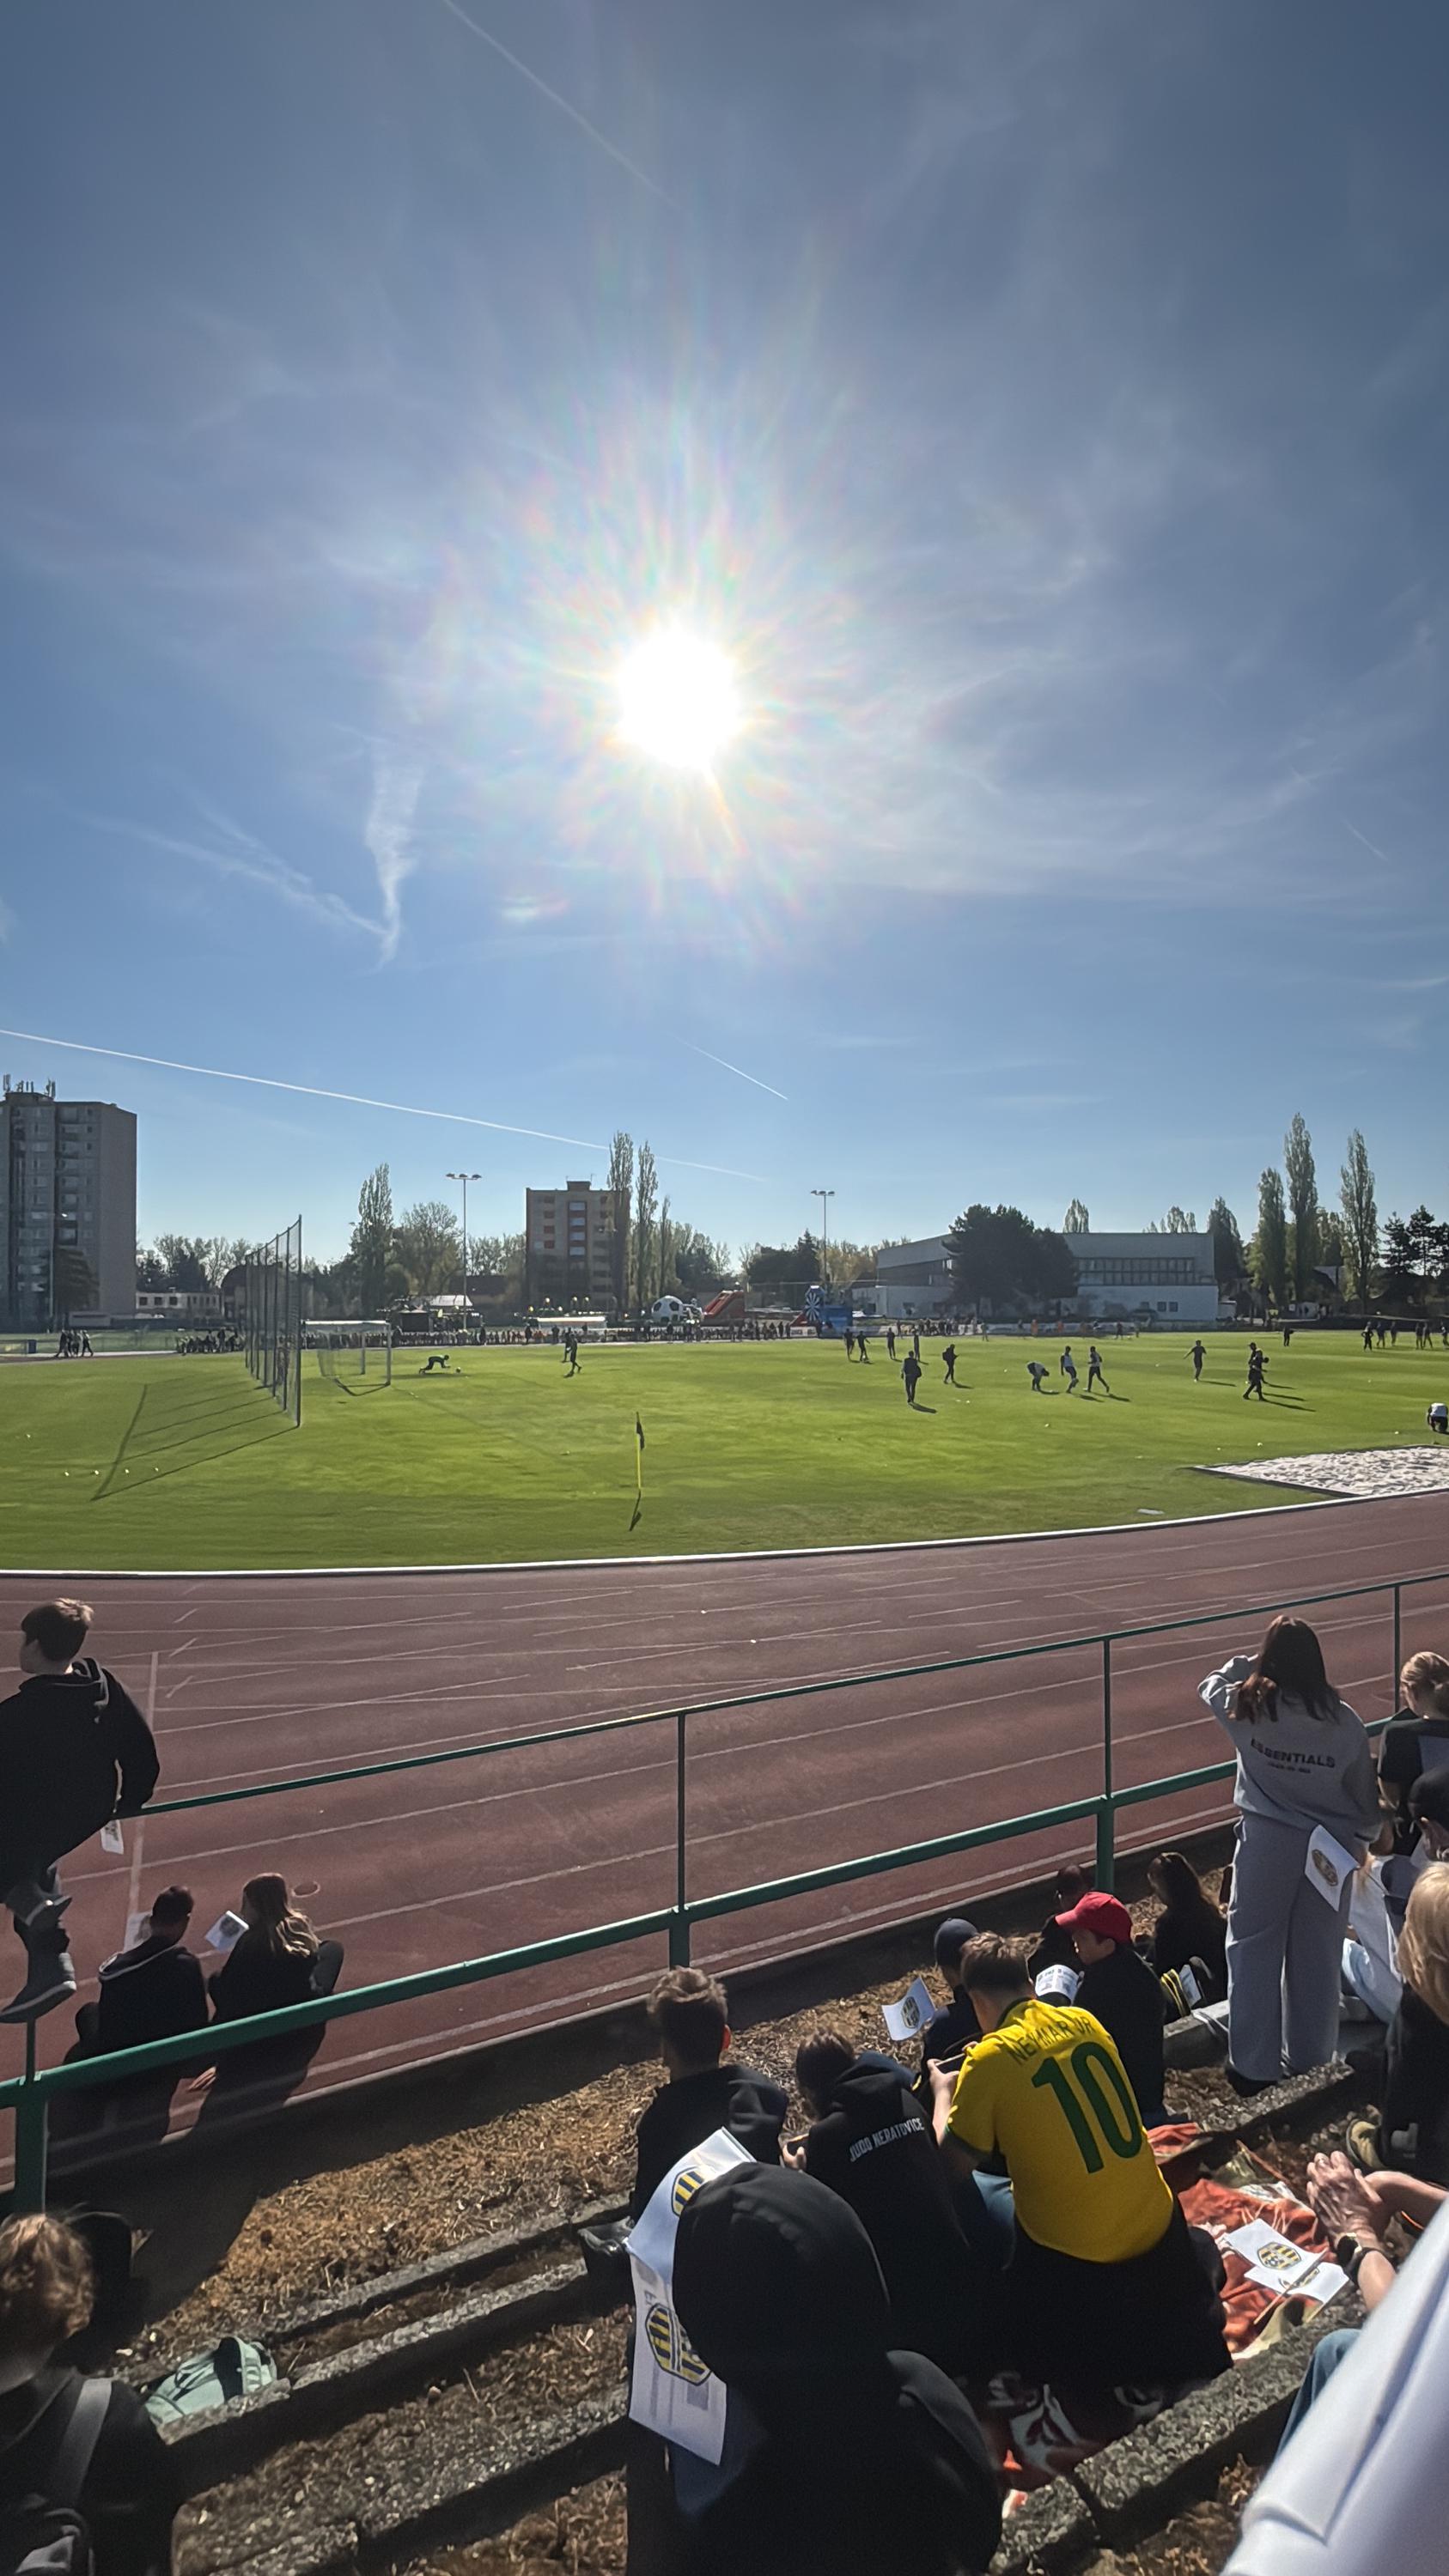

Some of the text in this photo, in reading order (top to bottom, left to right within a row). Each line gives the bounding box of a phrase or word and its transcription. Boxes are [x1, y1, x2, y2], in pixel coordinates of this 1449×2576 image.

[1251, 1739, 1335, 1768] ESSENTIALS
[1008, 2020, 1074, 2066] NEYMAR
[1032, 2041, 1142, 2173] 10
[849, 2117, 925, 2162] JUDO NERATOVICE
